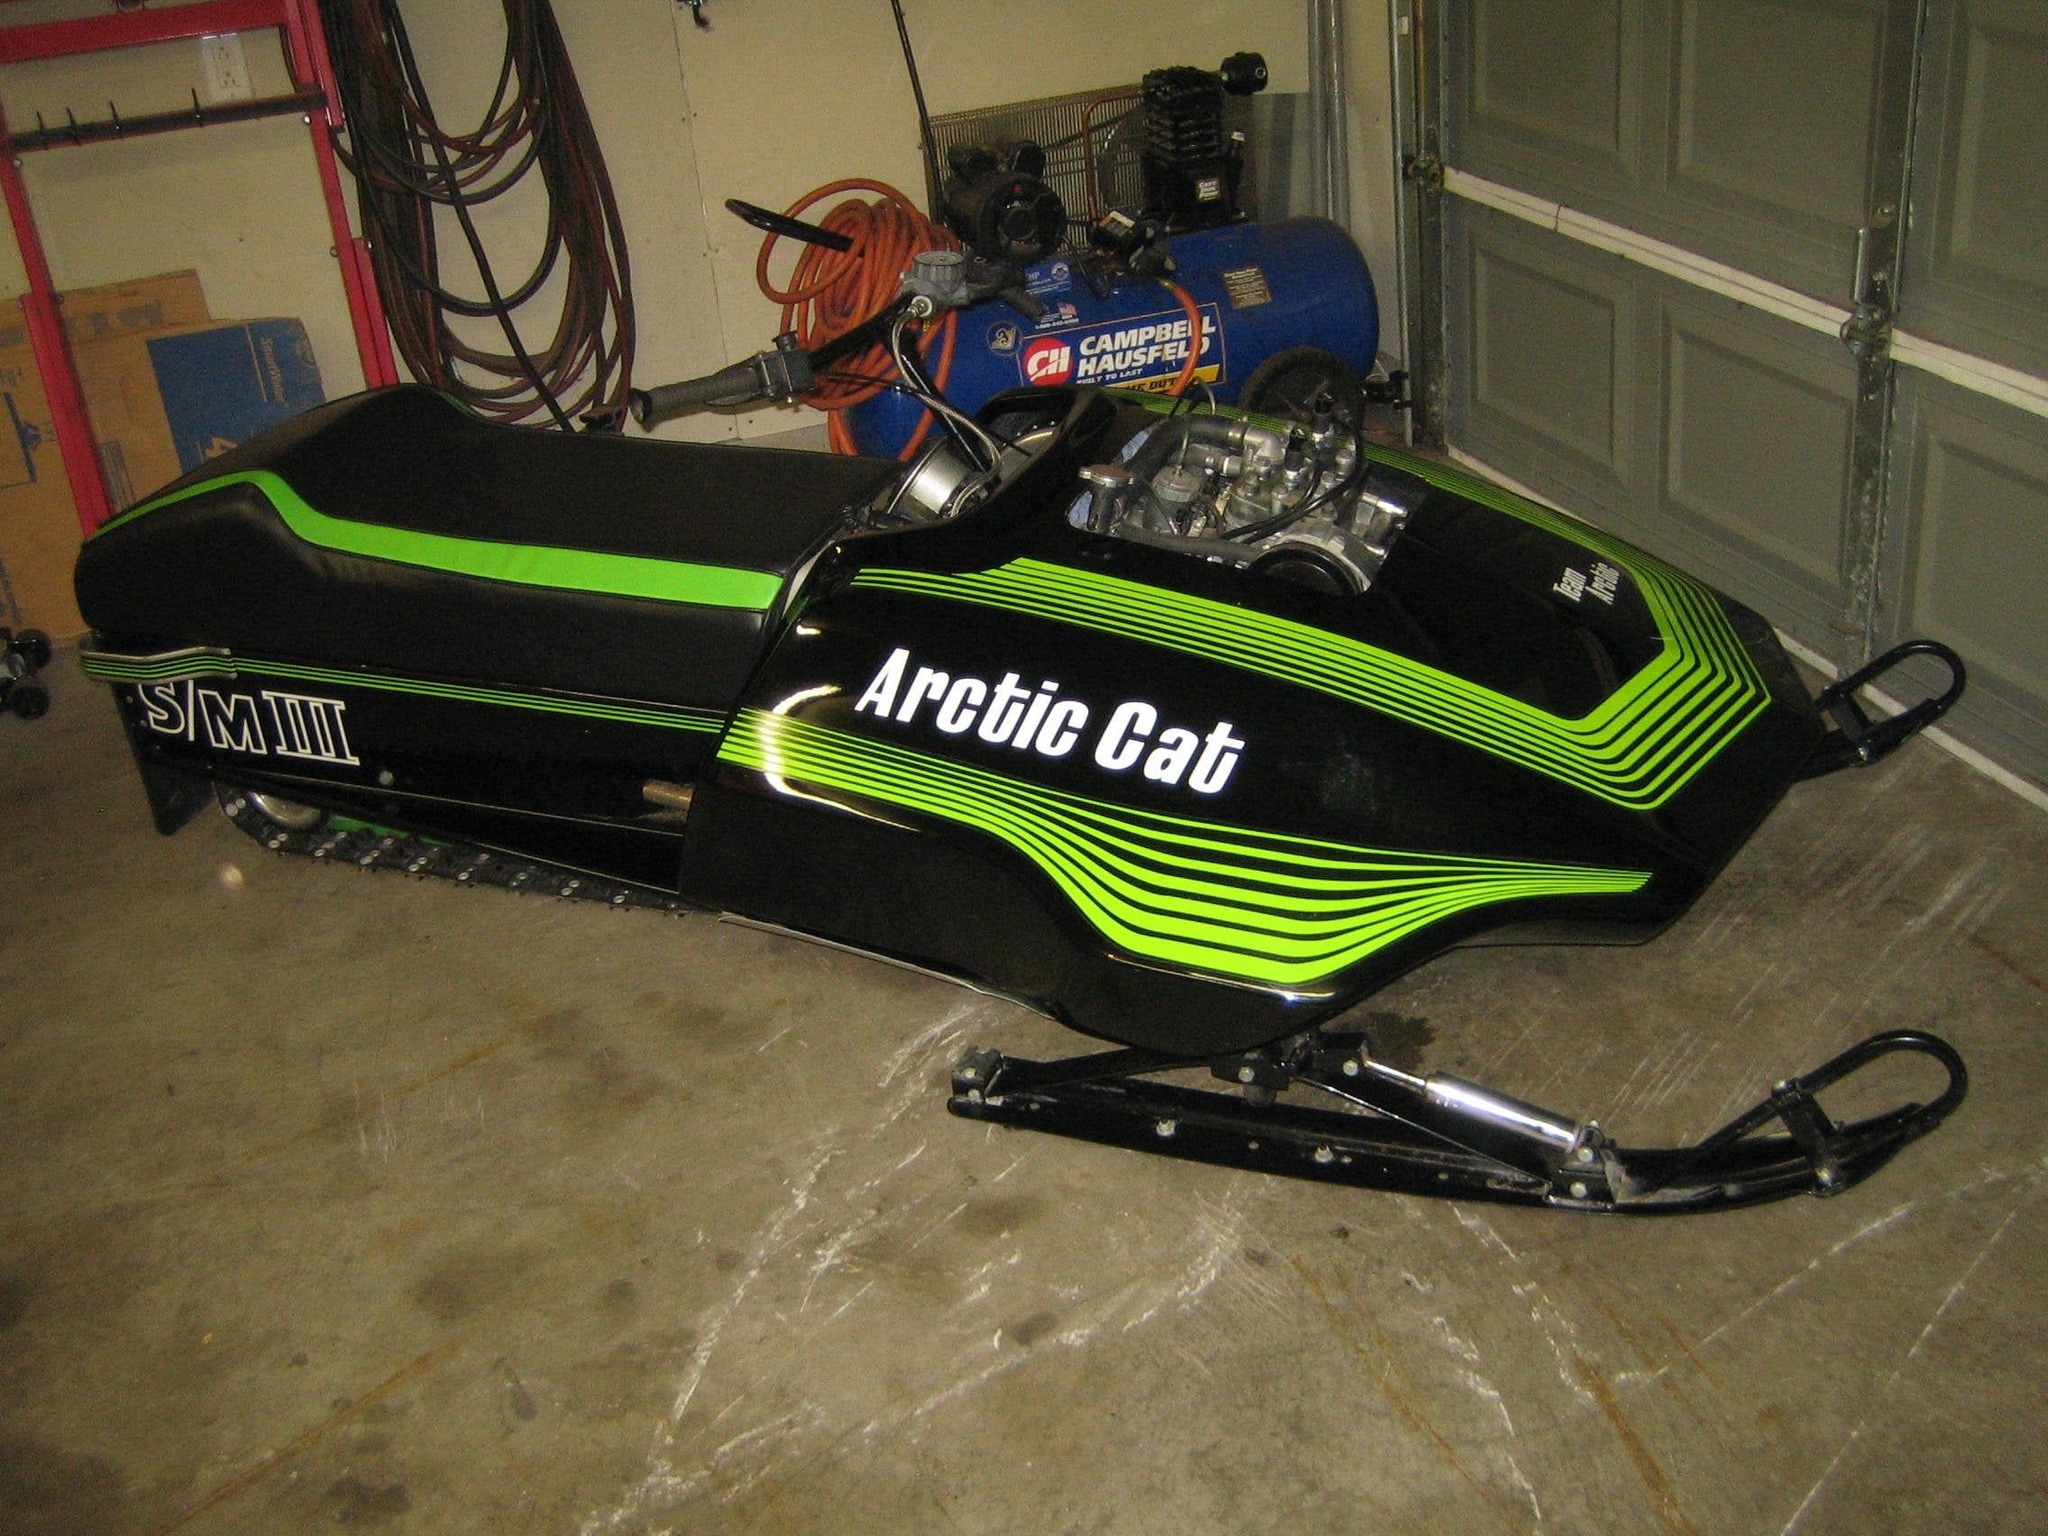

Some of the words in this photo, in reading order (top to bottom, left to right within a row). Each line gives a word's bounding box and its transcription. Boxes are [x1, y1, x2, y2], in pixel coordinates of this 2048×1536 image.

[1104, 372, 1119, 381] TO
[1119, 368, 1143, 378] LAST
[1149, 376, 1179, 390] DUT
[1552, 566, 1588, 602] Team
[1584, 561, 1620, 605] Arctic
[853, 647, 1089, 757] Arctic
[1094, 701, 1246, 794] Cat
